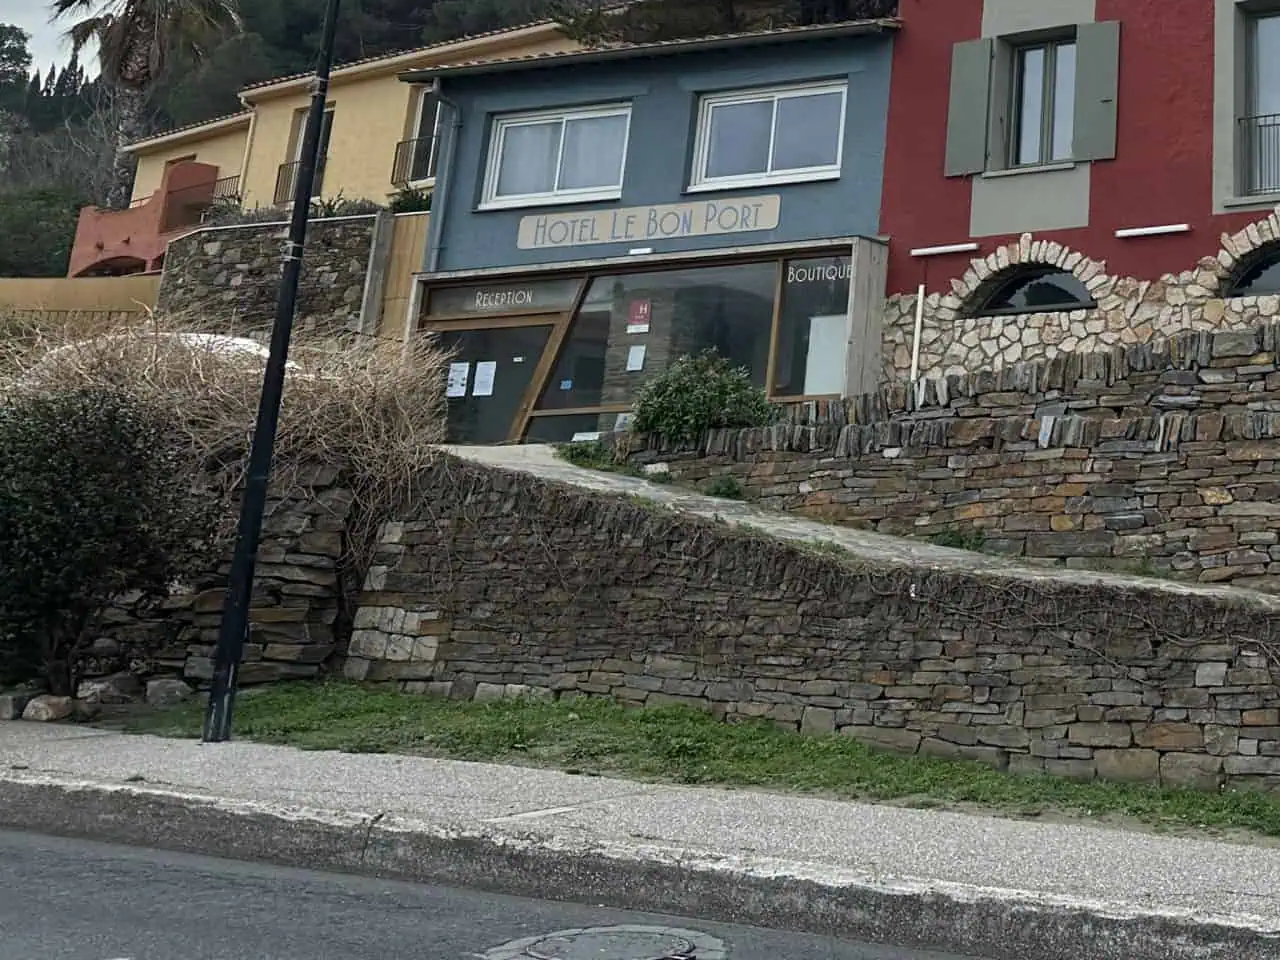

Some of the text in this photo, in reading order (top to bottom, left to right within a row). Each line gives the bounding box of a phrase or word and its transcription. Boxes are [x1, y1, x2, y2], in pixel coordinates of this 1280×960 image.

[533, 202, 763, 246] HOTEL LE BON PORT
[787, 264, 855, 284] BOUTIQUE
